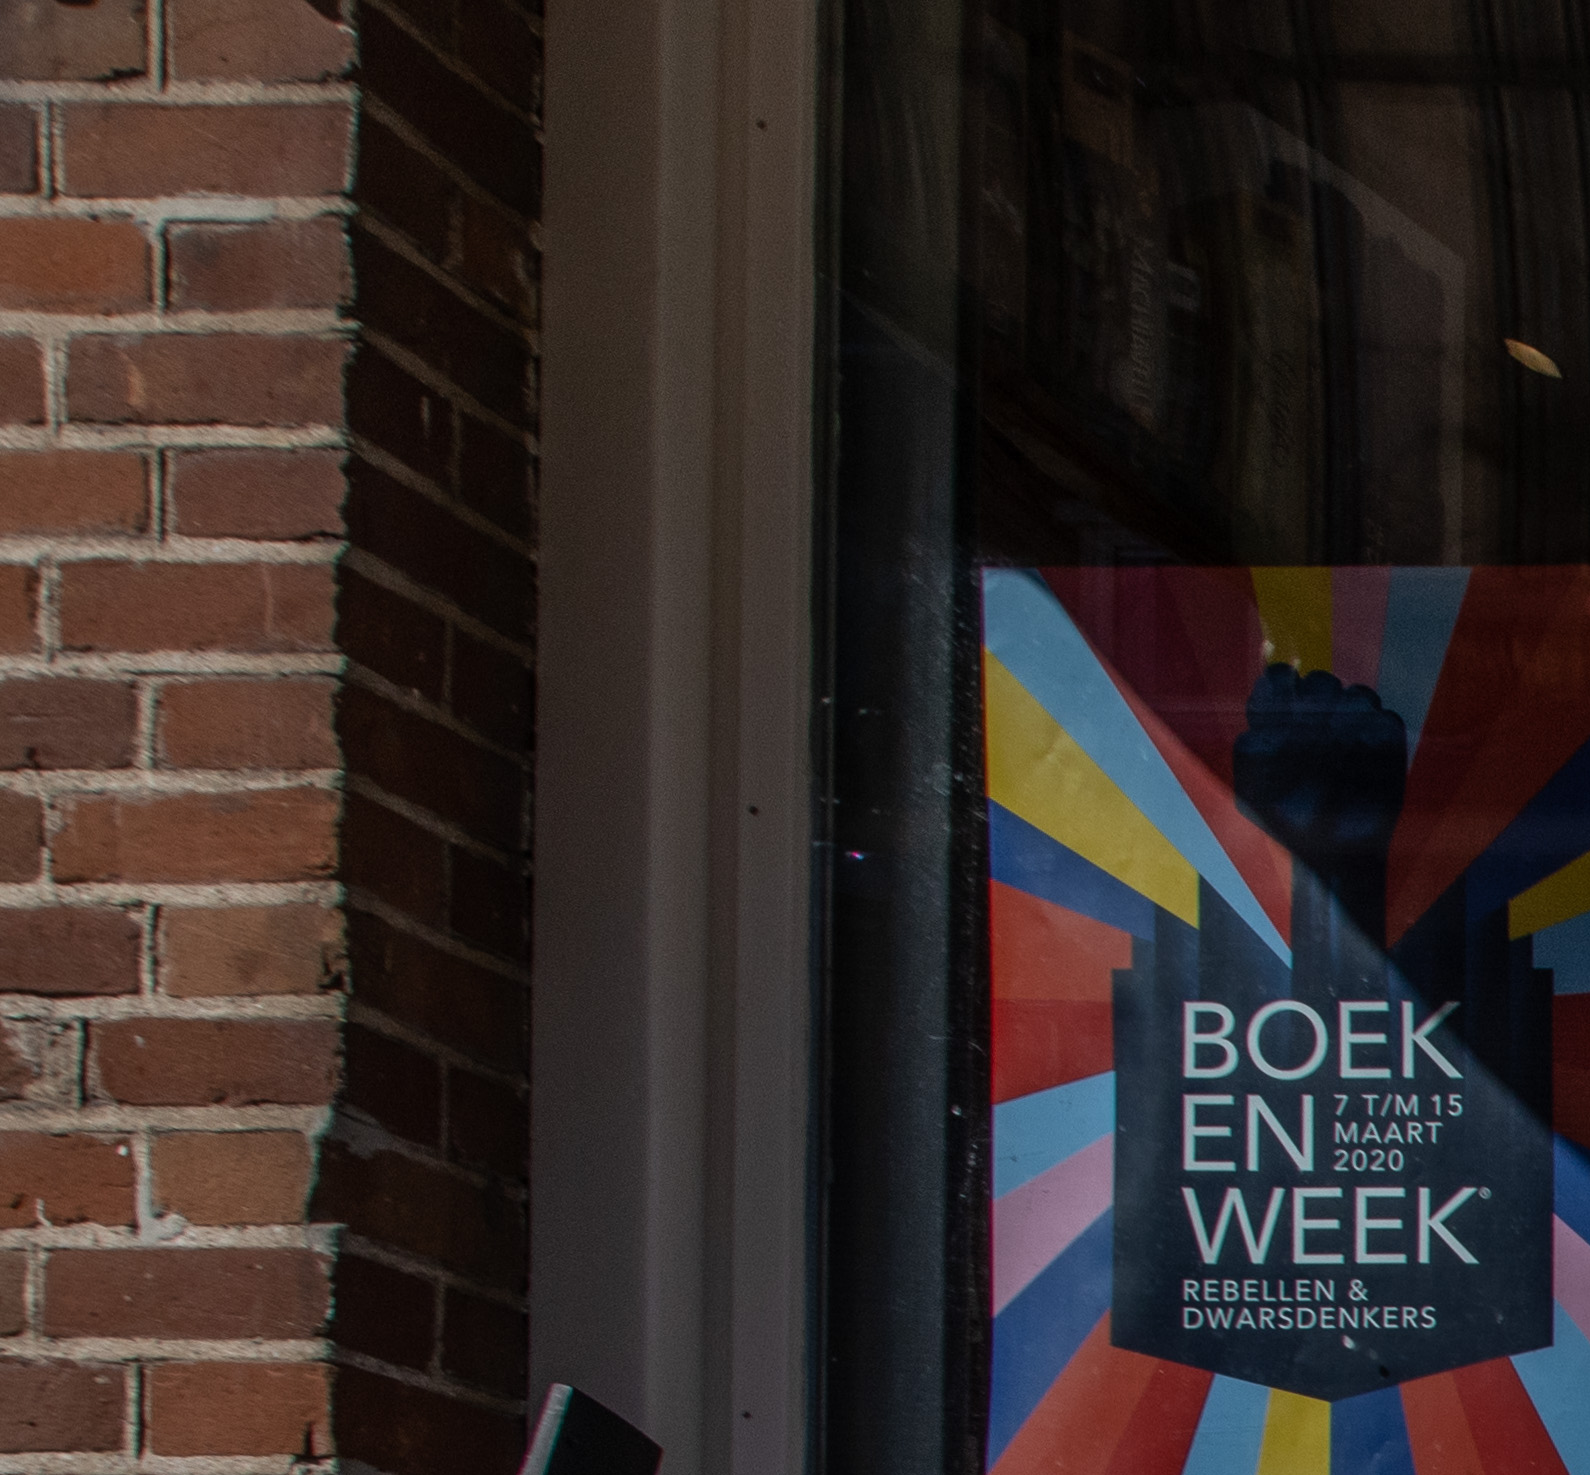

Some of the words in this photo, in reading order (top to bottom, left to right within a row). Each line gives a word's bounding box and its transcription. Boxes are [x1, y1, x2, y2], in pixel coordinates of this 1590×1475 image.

[1181, 1000, 1464, 1081] BOEK
[1181, 1093, 1315, 1173] EN
[1333, 1093, 1350, 1117] 7
[1361, 1093, 1422, 1118] T/M
[1429, 1093, 1465, 1118] 15
[1332, 1121, 1443, 1145] MAART
[1332, 1148, 1405, 1172] 2020
[1181, 1278, 1337, 1304] REBELLEN
[1346, 1278, 1370, 1304] &
[1181, 1305, 1438, 1331] DWARSDENKERS
